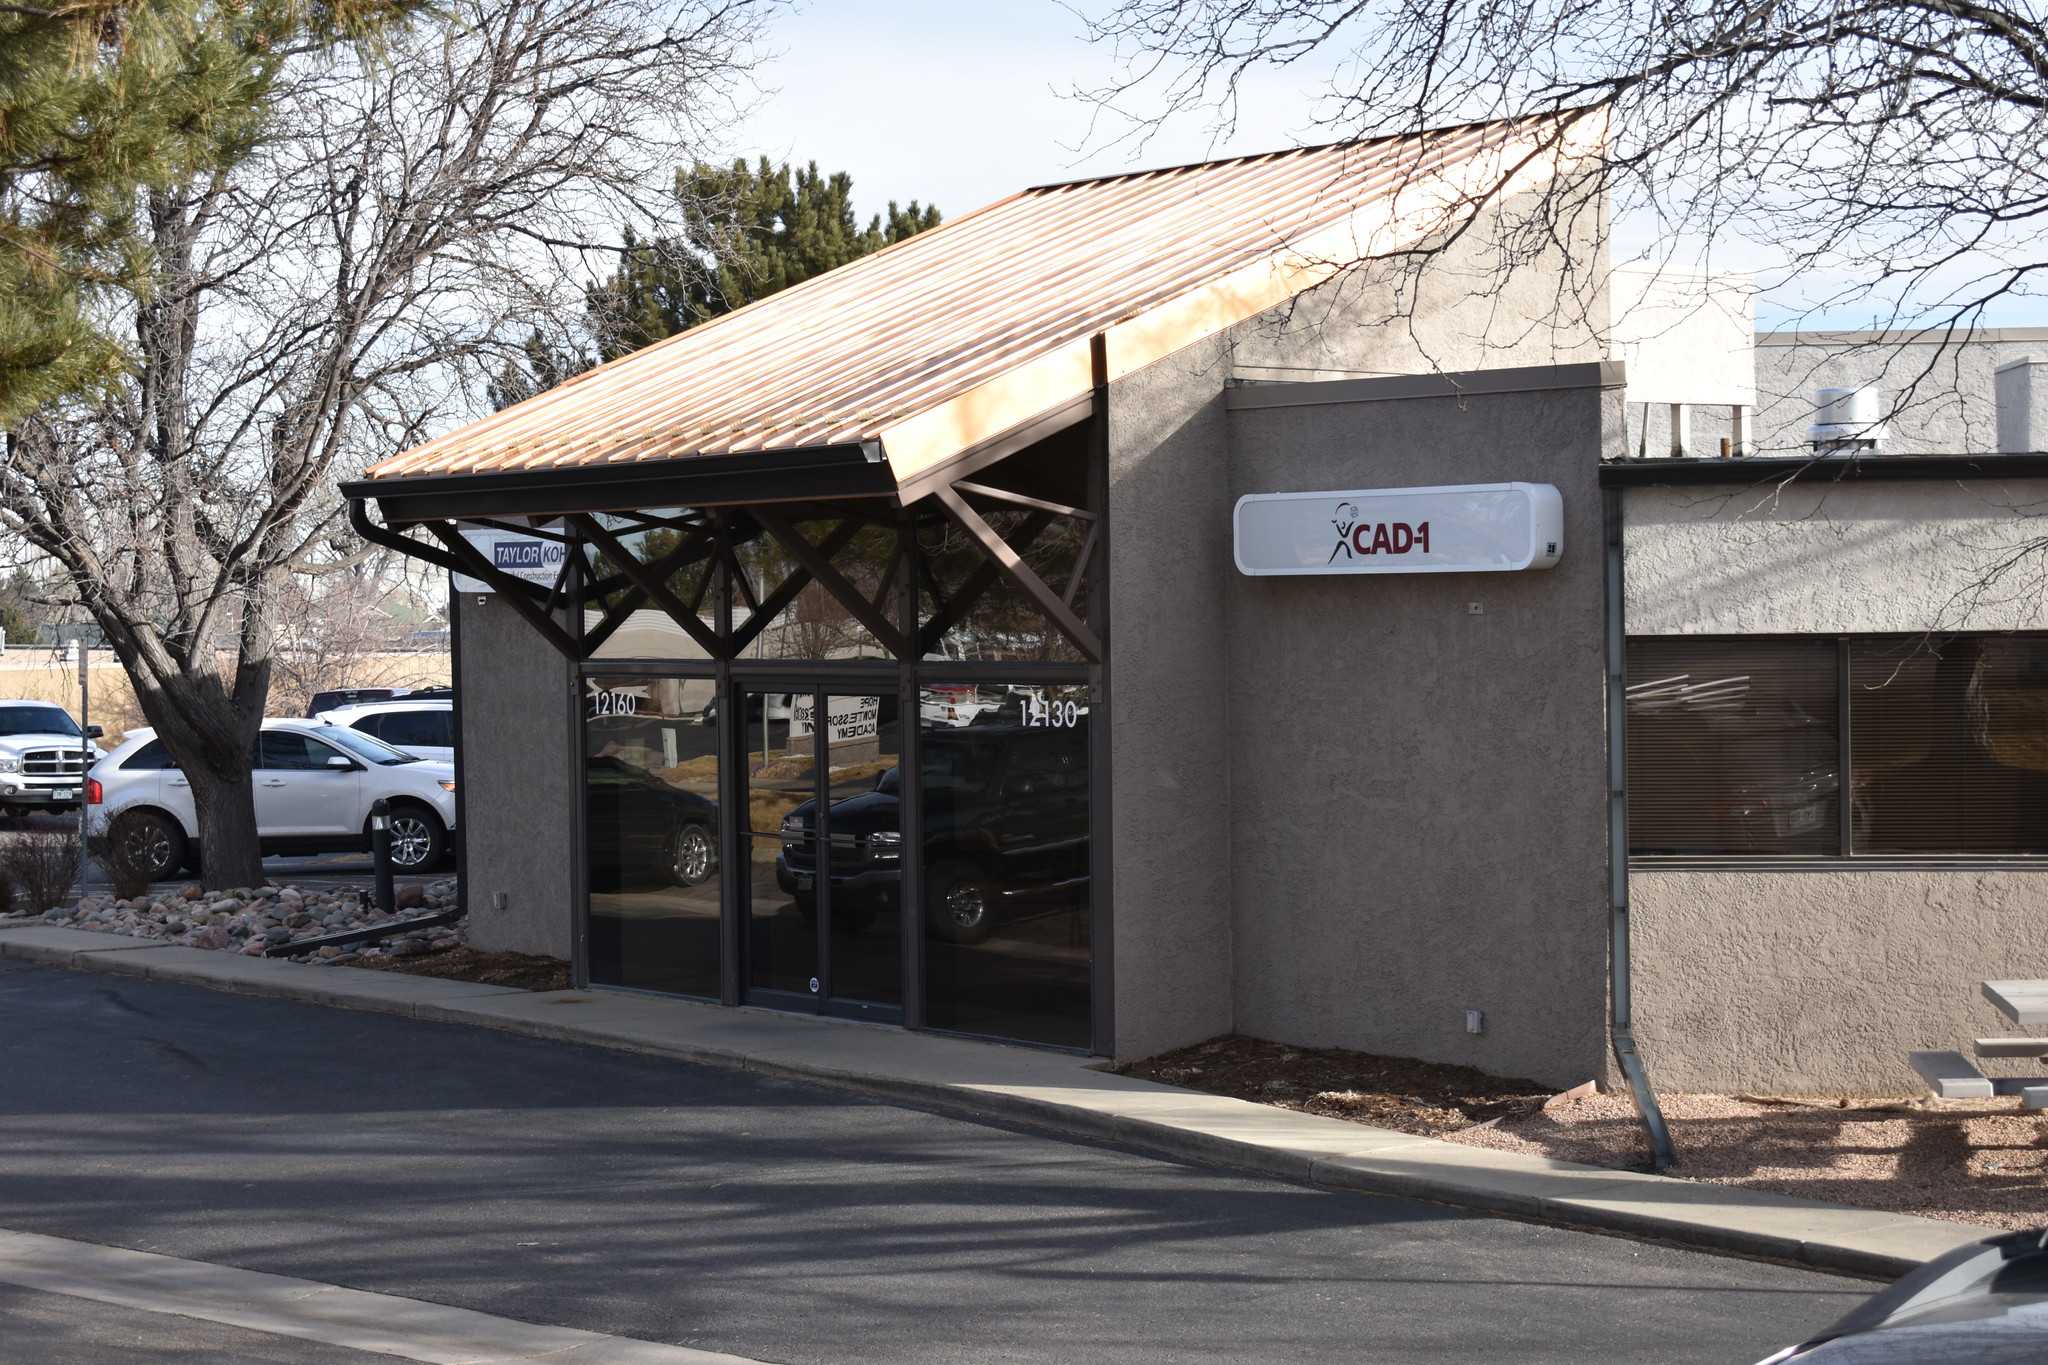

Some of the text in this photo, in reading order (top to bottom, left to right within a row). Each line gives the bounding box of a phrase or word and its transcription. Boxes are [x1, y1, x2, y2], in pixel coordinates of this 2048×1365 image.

[1353, 521, 1430, 555] CAD-1
[496, 546, 539, 563] TAYLOR
[595, 692, 635, 715] 12160
[1020, 700, 1077, 728] 12130
